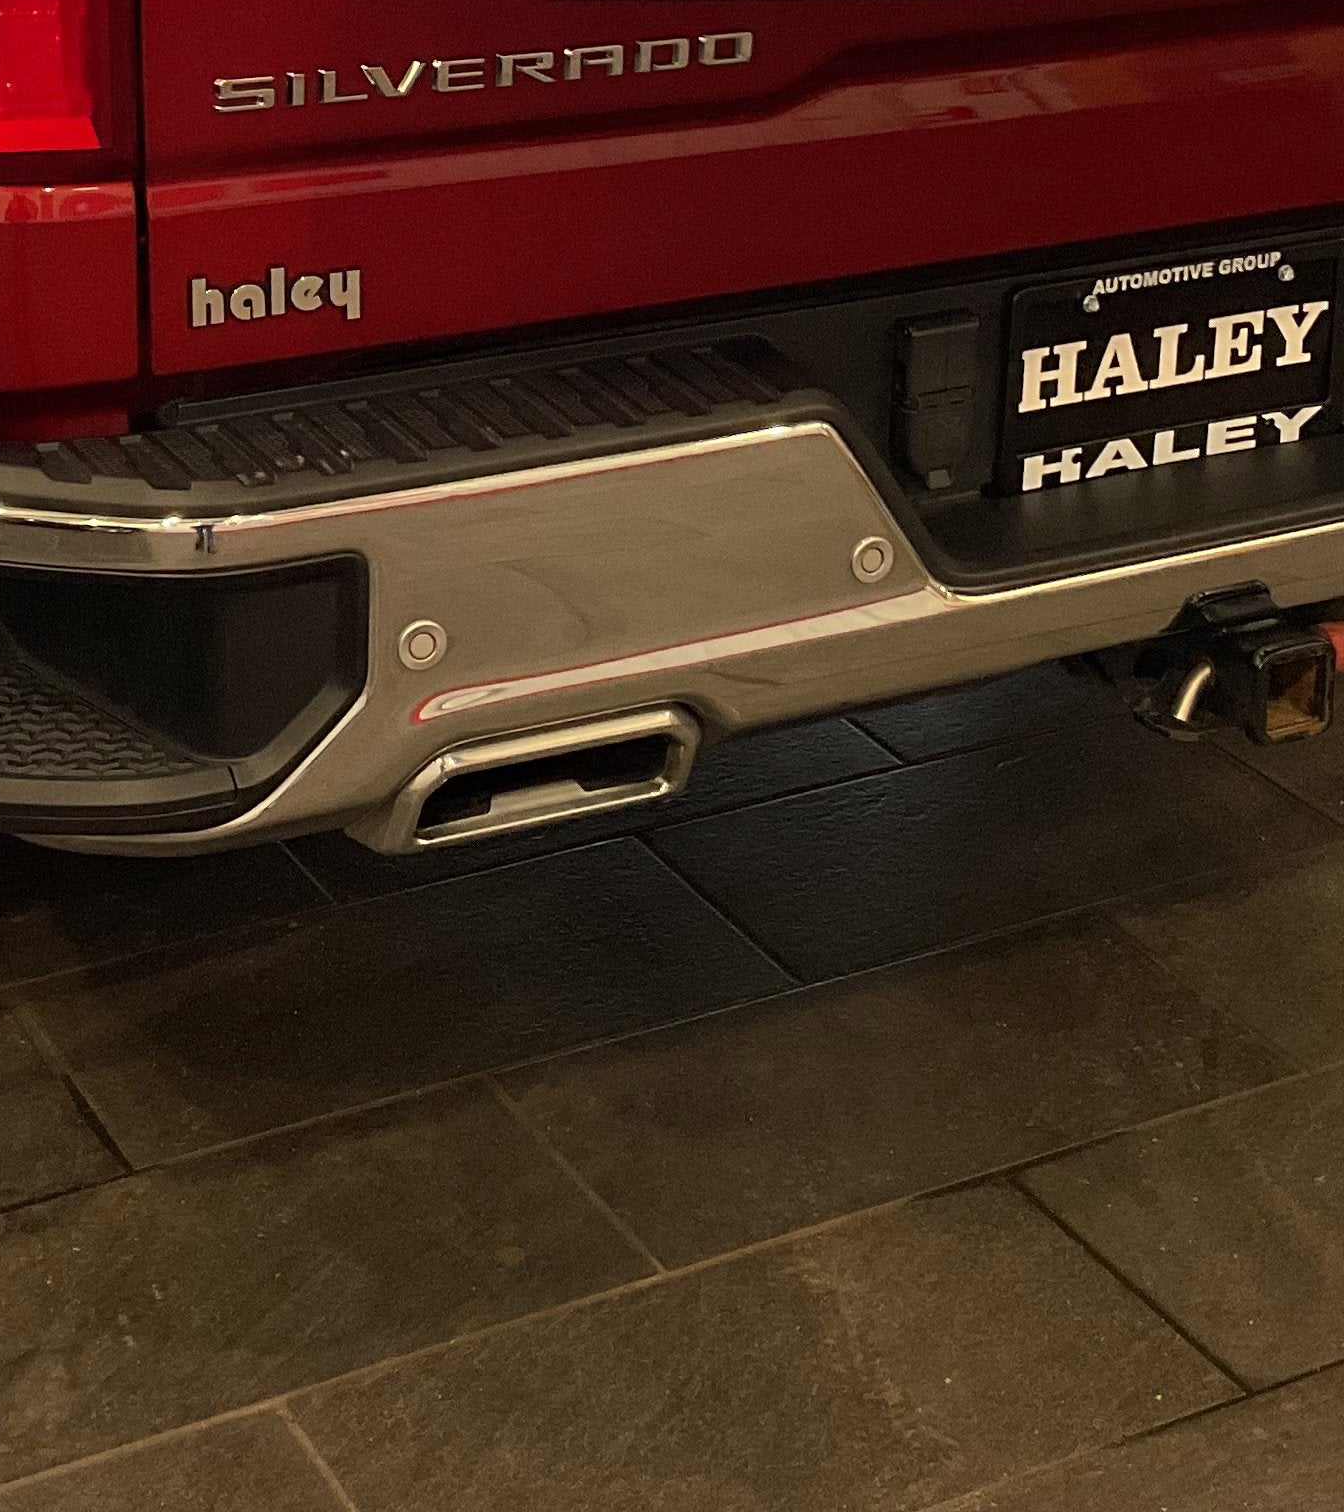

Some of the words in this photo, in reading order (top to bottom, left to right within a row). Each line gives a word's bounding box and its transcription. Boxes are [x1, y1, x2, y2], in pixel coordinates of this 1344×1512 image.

[213, 31, 755, 114] SILVERADO
[189, 265, 363, 328] haley
[1092, 261, 1214, 296] AUTOMOTIVE
[1218, 251, 1283, 276] GROUP
[1017, 300, 1329, 414] HALEY
[1021, 405, 1324, 492] HALEY
